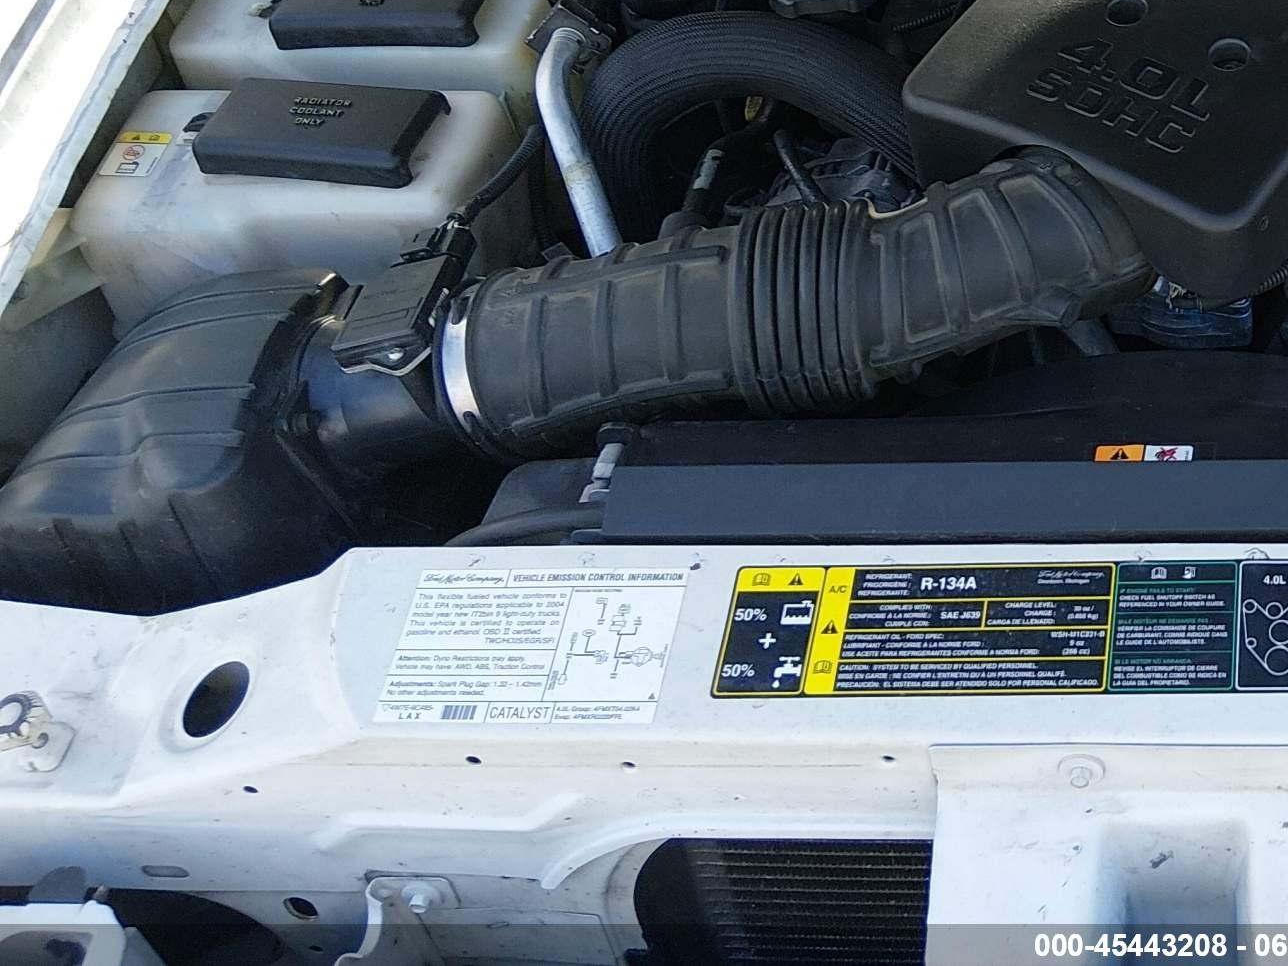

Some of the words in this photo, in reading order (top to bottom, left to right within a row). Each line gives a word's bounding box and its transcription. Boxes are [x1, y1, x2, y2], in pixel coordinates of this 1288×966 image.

[293, 96, 352, 106] RADIATOR
[289, 107, 343, 117] COOLANT
[1026, 68, 1196, 153] SOHC
[513, 574, 545, 582] VEHICLE
[547, 573, 586, 582] EMISSION
[588, 573, 624, 581] CONTROL
[628, 573, 683, 581] INFORMATION
[1263, 574, 1286, 584] 4.0L
[921, 577, 977, 590] R-134A
[829, 585, 847, 593] A/C
[495, 601, 532, 610] applicable
[734, 608, 768, 621] 50%
[960, 611, 980, 619] J639
[406, 629, 436, 637] gasoline
[434, 655, 451, 663] Dyno
[721, 664, 755, 677] 50%
[489, 706, 550, 719] CATALYST
